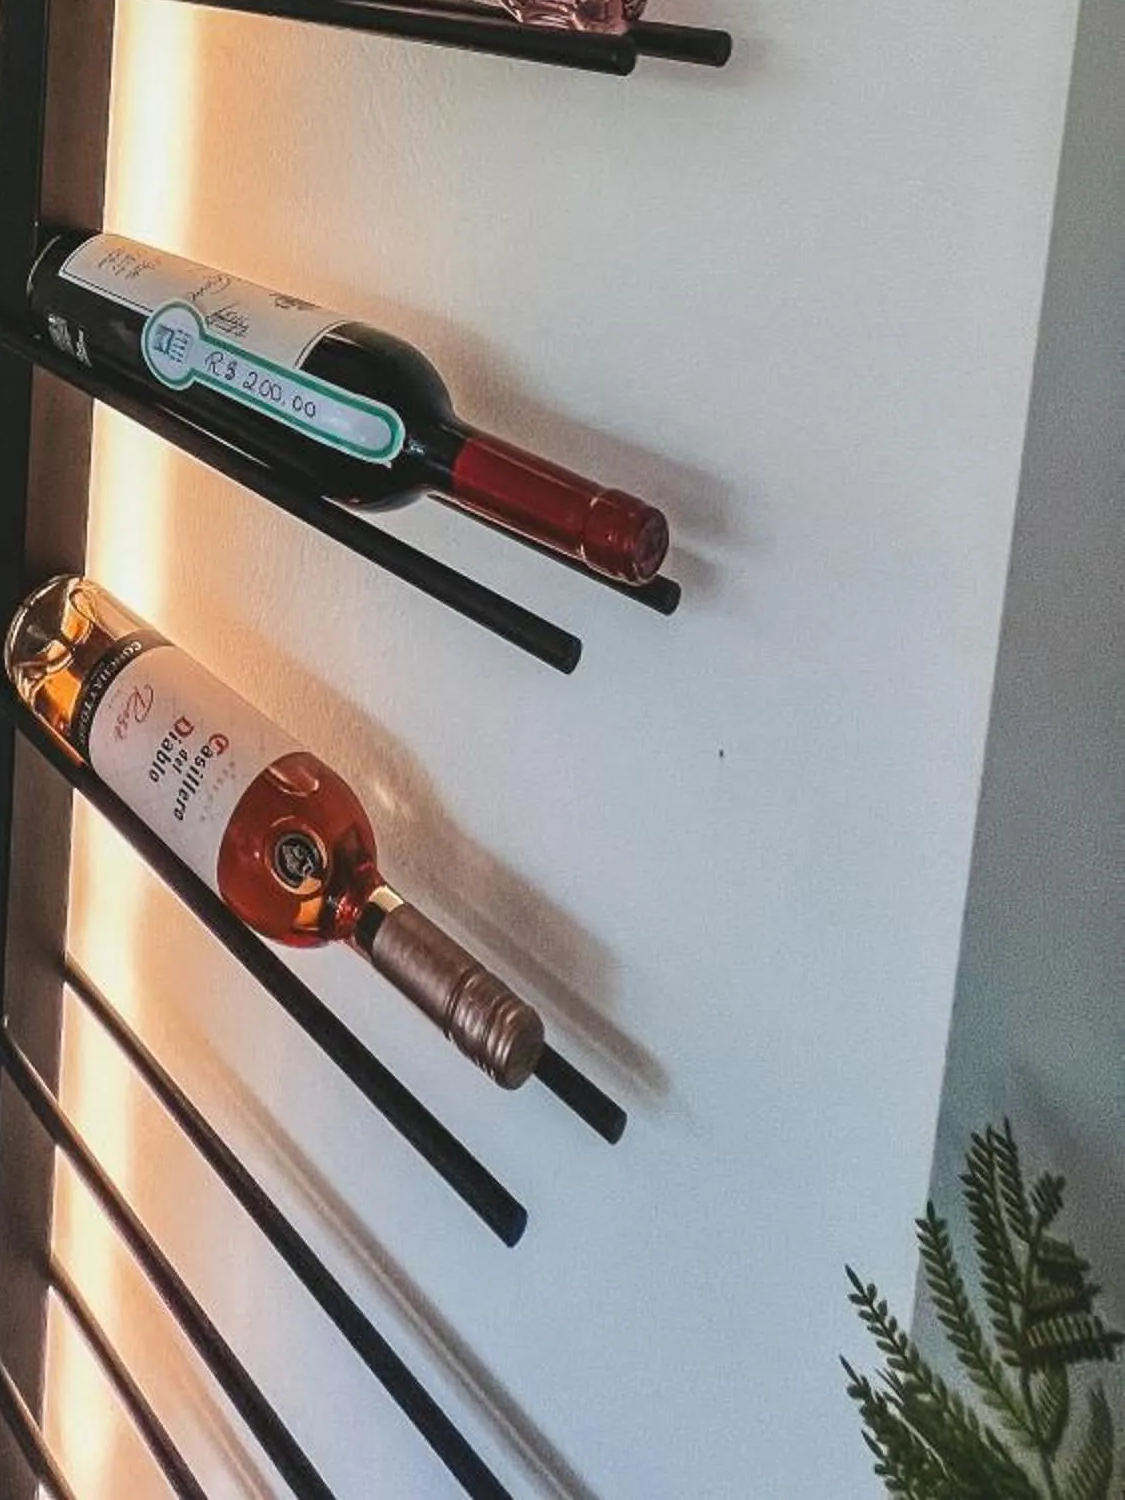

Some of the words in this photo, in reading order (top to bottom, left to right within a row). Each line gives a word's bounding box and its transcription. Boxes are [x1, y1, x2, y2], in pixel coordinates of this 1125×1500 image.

[149, 715, 195, 784] Diablo
[172, 748, 189, 775] del
[173, 732, 230, 821] Casillero
